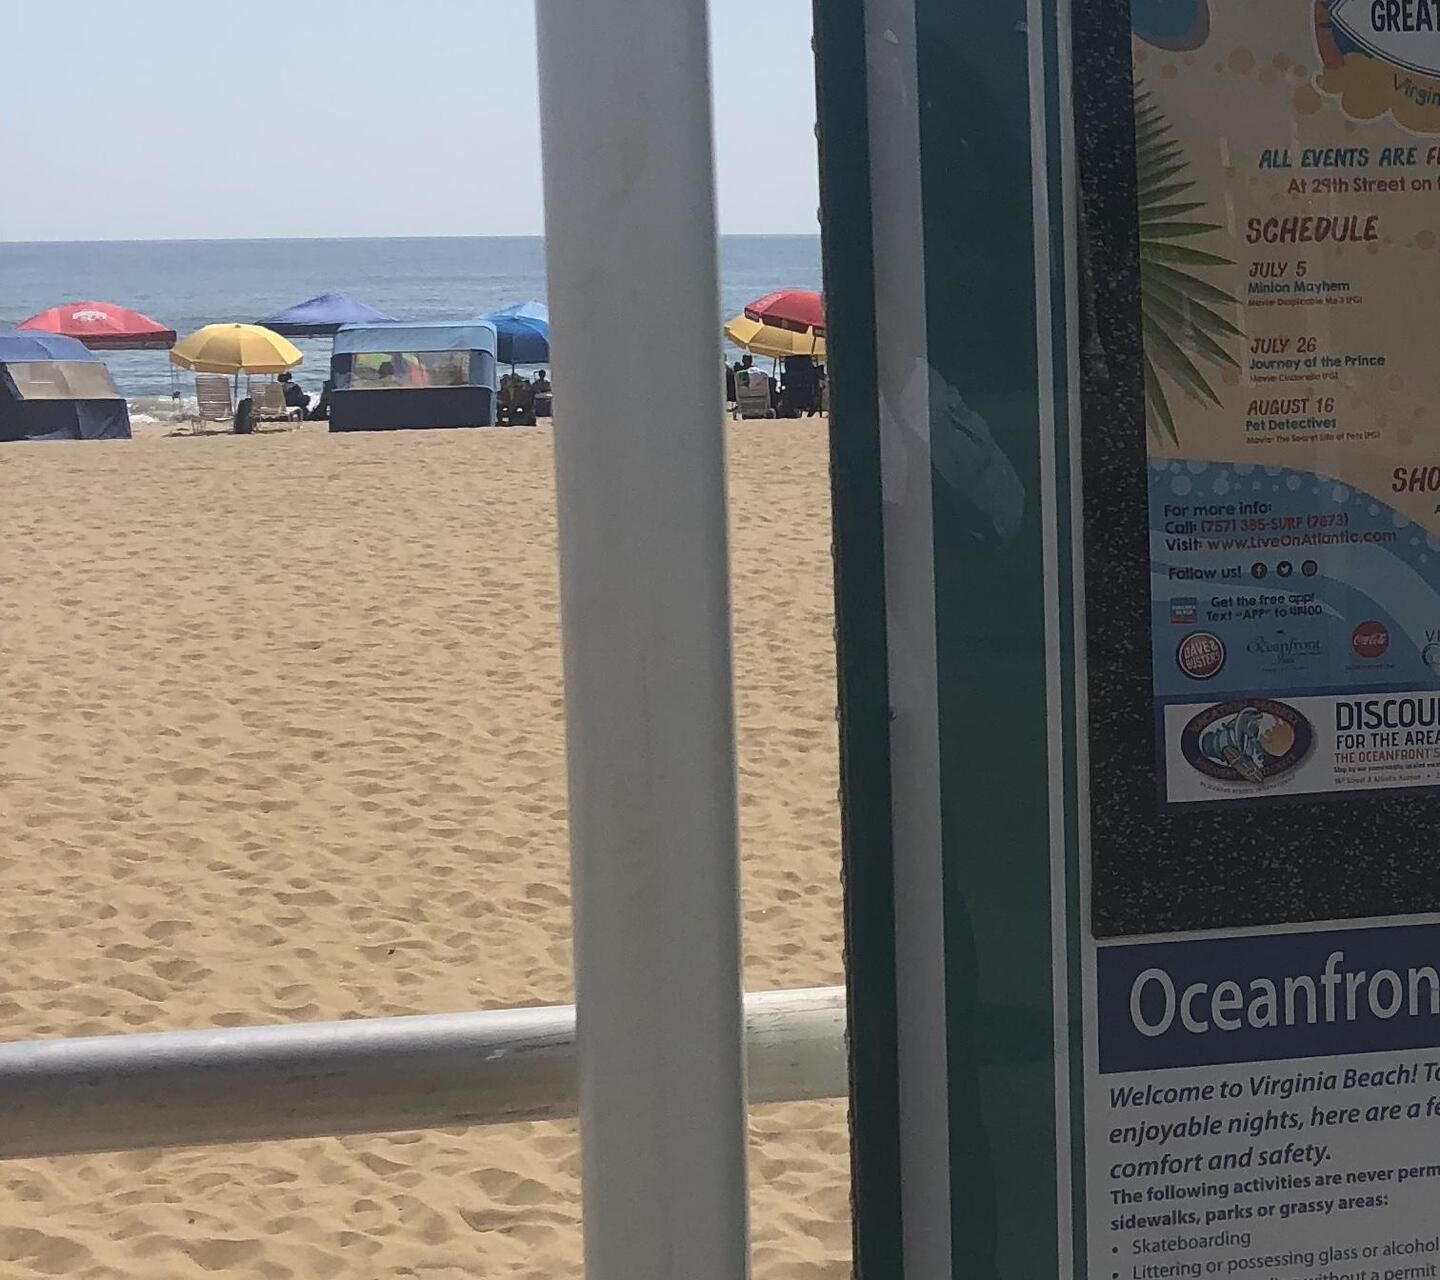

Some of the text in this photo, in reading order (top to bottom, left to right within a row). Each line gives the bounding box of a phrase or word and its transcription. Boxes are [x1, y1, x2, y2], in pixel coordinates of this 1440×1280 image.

[1258, 147, 1292, 170] ALL
[1301, 147, 1369, 169] EVENTS
[1378, 146, 1418, 168] ARE
[1287, 177, 1307, 195] At
[1311, 176, 1349, 194] 29th
[1352, 176, 1406, 194] Street
[1410, 178, 1432, 192] on
[1246, 215, 1379, 244] SCHEDULE
[1249, 260, 1307, 278] JULY 5
[1248, 281, 1350, 295] Minion Mayhem
[1251, 336, 1317, 354] JULY 26
[1247, 397, 1335, 416] AUGUST 16
[1164, 501, 1272, 518] For more info:
[1168, 566, 1242, 580] Follow us!
[1336, 732, 1366, 751] FOR
[1370, 730, 1400, 749] THE
[1334, 751, 1355, 765] THE
[1358, 746, 1440, 764] OCEANFRONT'S
[1110, 1083, 1215, 1109] Welcome
[1220, 1080, 1243, 1100] to
[1249, 1070, 1338, 1100] Virginia
[1342, 1062, 1418, 1090] Beach!
[1109, 1114, 1223, 1148] enjoyable
[1227, 1109, 1304, 1138] nights,
[1310, 1104, 1361, 1127] here
[1365, 1103, 1402, 1123] are
[1406, 1102, 1421, 1120] a
[1110, 1142, 1331, 1180] comfort and safety.
[1109, 1187, 1143, 1206] The
[1146, 1181, 1229, 1202] following
[1233, 1173, 1311, 1195] activities
[1314, 1172, 1343, 1187] are
[1346, 1169, 1394, 1185] never
[1110, 1194, 1389, 1232] sidewalks, parks or grassy areas:
[1132, 1230, 1251, 1255] Skateboarding
